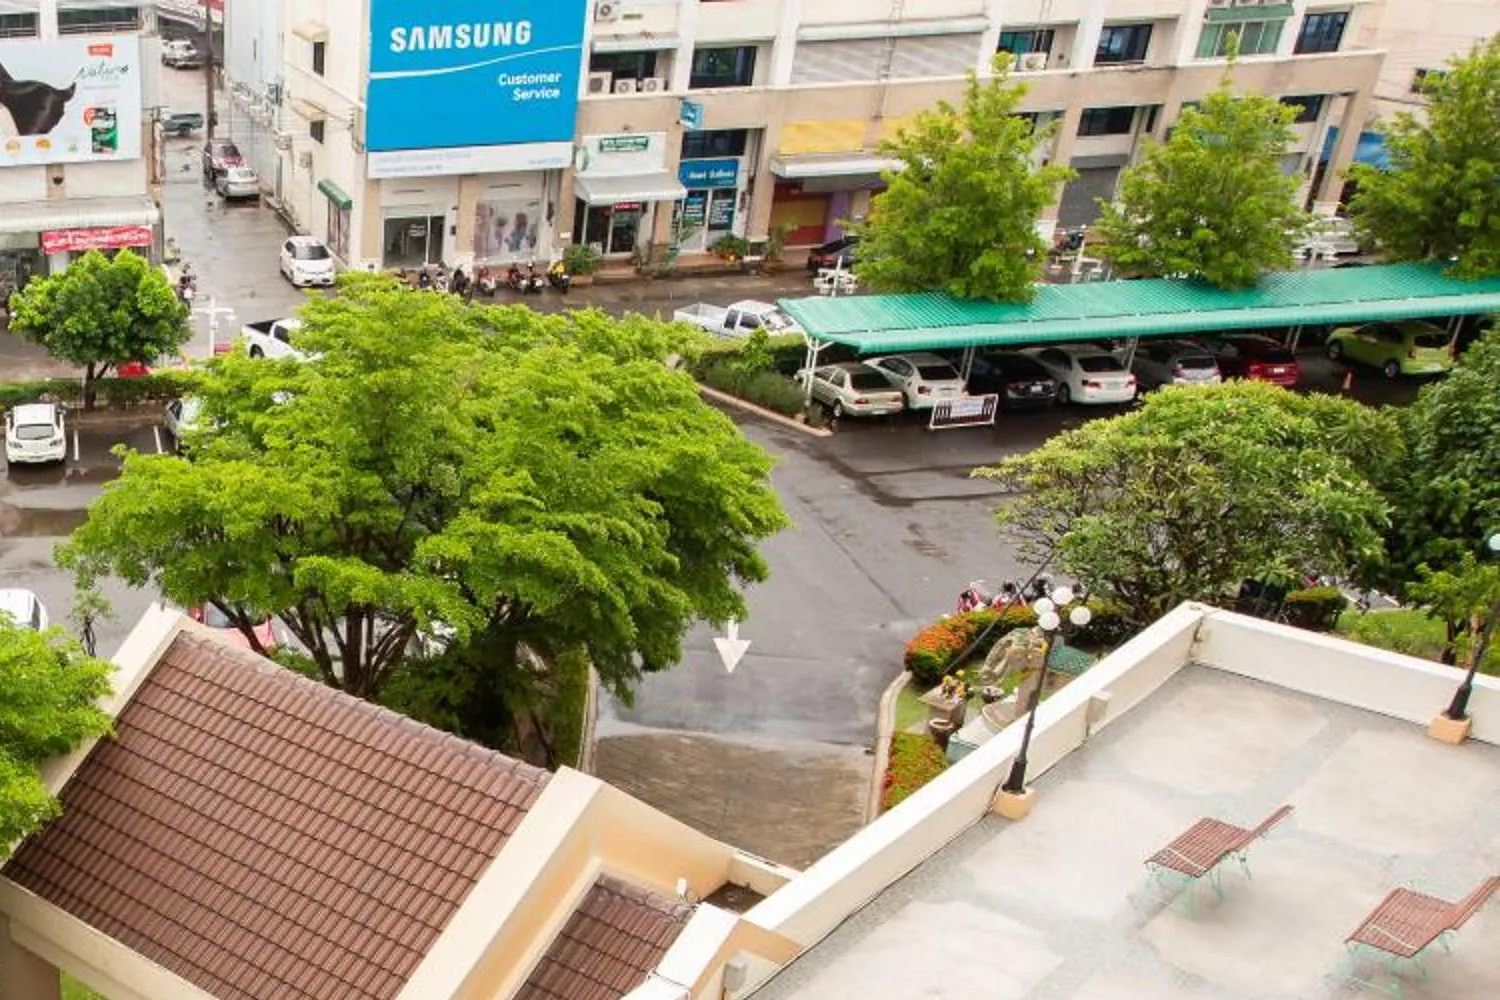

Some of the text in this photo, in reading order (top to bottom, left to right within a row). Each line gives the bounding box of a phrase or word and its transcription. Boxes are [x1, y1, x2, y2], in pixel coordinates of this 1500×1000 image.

[390, 20, 532, 53] SAMSUNG
[498, 71, 562, 86] Customer
[512, 87, 561, 101] Service
